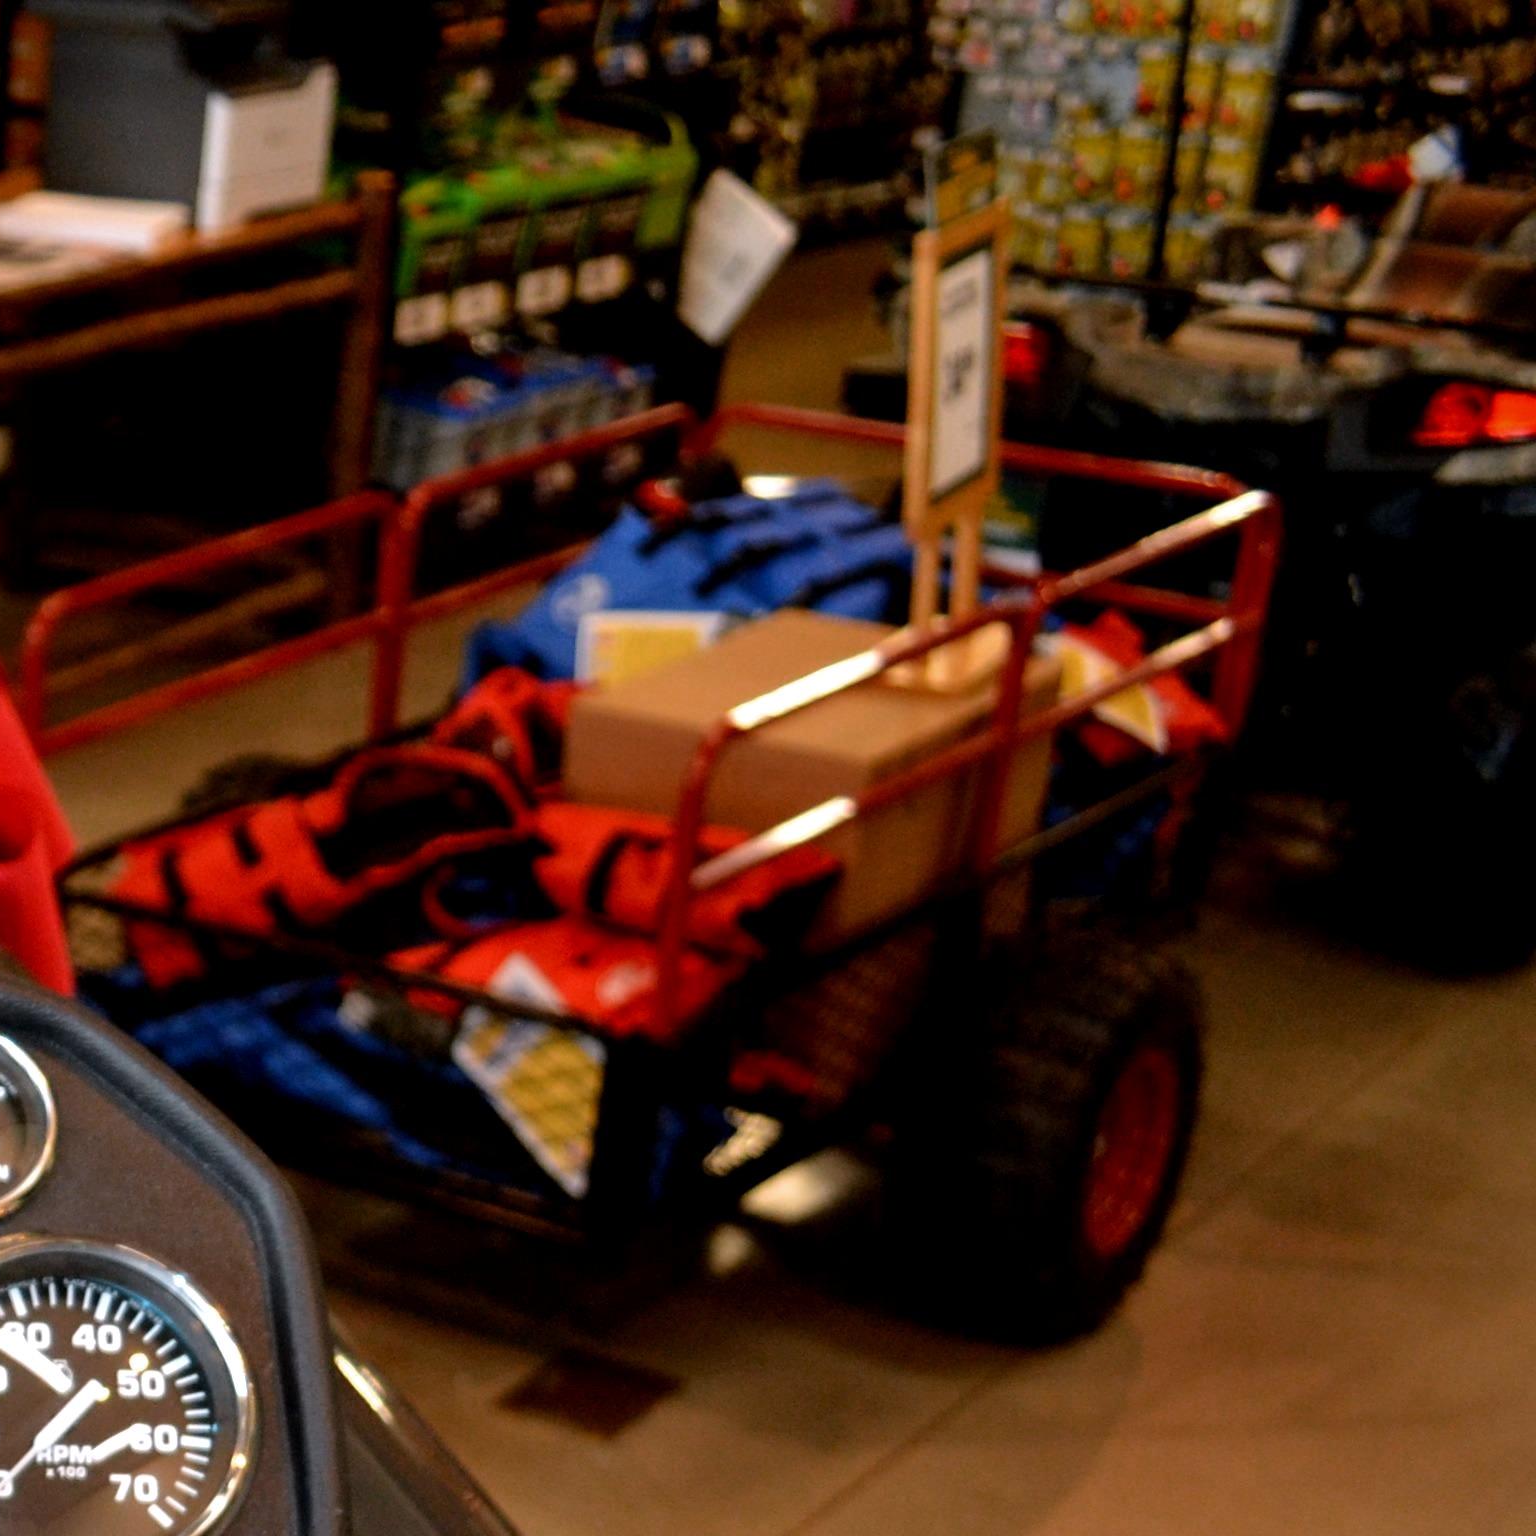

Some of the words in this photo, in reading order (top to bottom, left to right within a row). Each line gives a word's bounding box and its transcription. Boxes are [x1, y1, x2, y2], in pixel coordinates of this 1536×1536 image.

[71, 1323, 123, 1353] 40
[116, 1368, 166, 1398] 50
[130, 1422, 180, 1453] 60
[35, 1445, 94, 1466] RPM
[108, 1473, 159, 1503] 70
